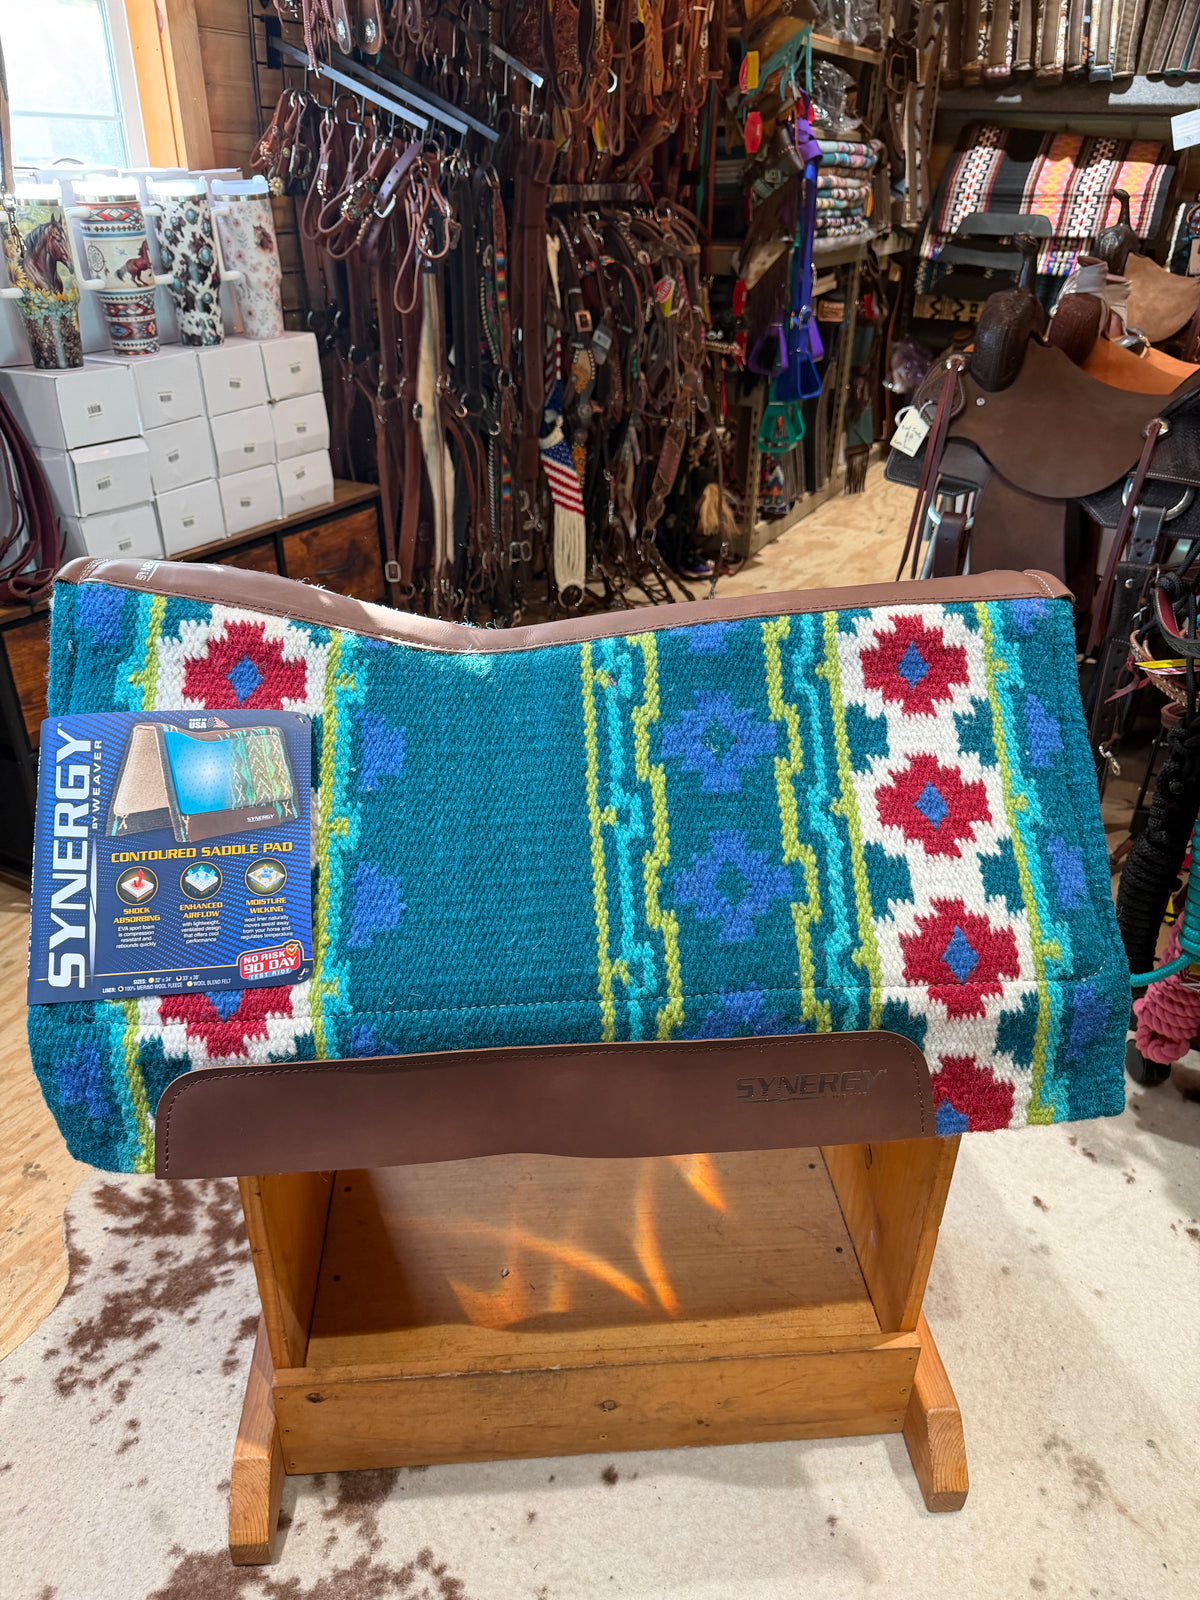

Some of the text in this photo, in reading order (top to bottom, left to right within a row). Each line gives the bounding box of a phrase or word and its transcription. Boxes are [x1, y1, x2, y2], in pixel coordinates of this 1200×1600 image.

[189, 721, 206, 729] USA
[92, 740, 102, 830] BY WEAVER
[111, 842, 292, 863] CONTOURED SADDLE PAD
[48, 727, 92, 989] SYNERGY
[179, 902, 223, 911] ENHANCED
[246, 898, 287, 906] MOISTURE
[123, 907, 150, 915] SHOCK
[249, 906, 284, 914] WICKING
[113, 915, 160, 924] ABSORBING
[183, 911, 219, 919] AIRFLOW
[244, 951, 285, 964] NO RISK
[244, 956, 296, 974] 90 DAY
[272, 968, 290, 976] RIDE
[735, 1069, 884, 1099] SYNERGY
